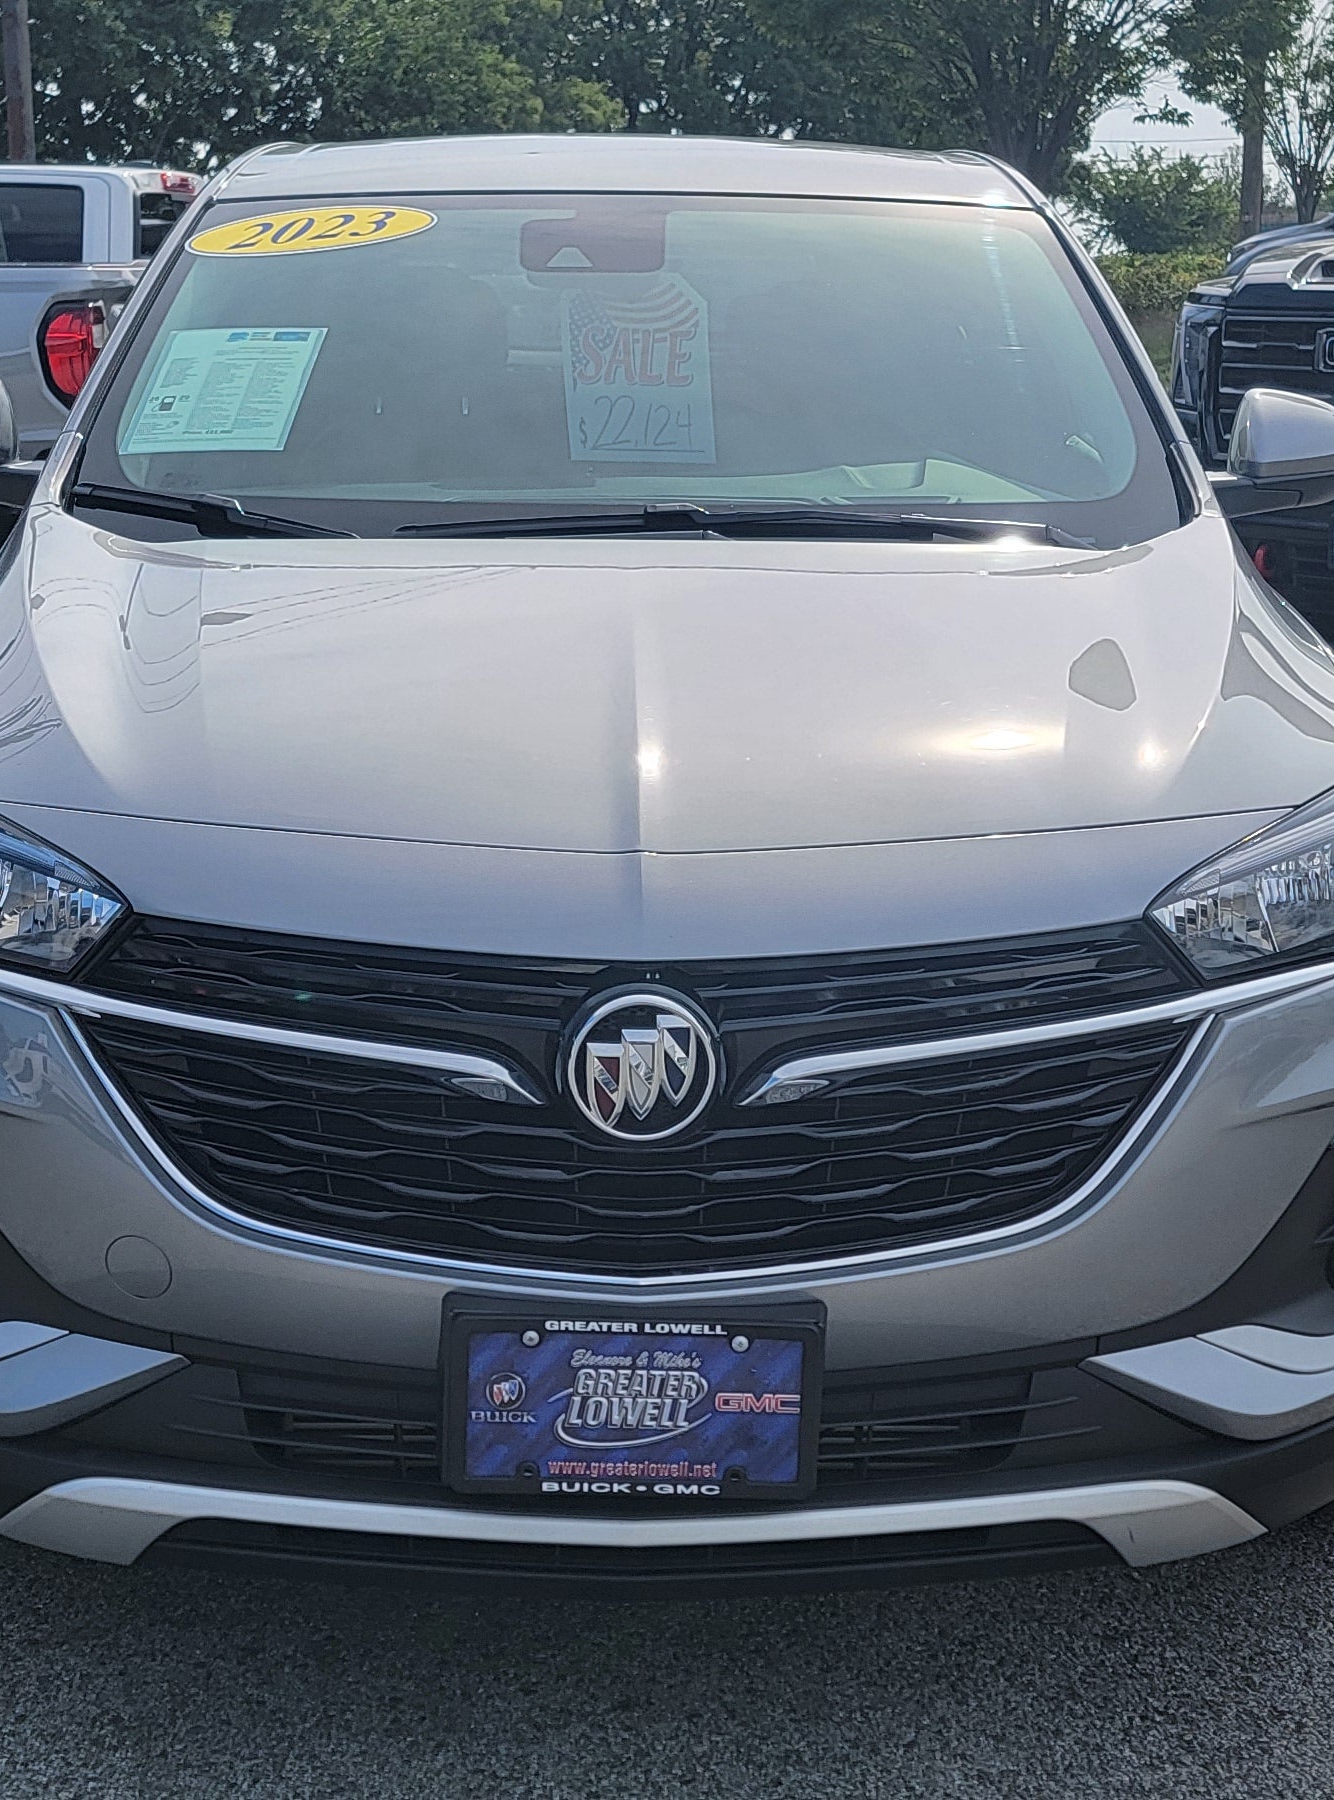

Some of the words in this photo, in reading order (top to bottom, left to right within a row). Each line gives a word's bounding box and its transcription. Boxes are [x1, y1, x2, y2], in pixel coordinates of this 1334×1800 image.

[223, 210, 396, 250] 2023
[574, 325, 698, 387] SALE
[544, 1320, 638, 1334] GREATER
[643, 1322, 728, 1336] LOWELL
[574, 1368, 701, 1400] GREATER
[564, 1395, 690, 1430] LOWELL
[714, 1391, 802, 1415] GMC
[470, 1410, 538, 1424] BUICK
[547, 1460, 718, 1479] www.greaterlowell.net
[541, 1481, 632, 1494] BUICK
[652, 1483, 721, 1496] GMC
